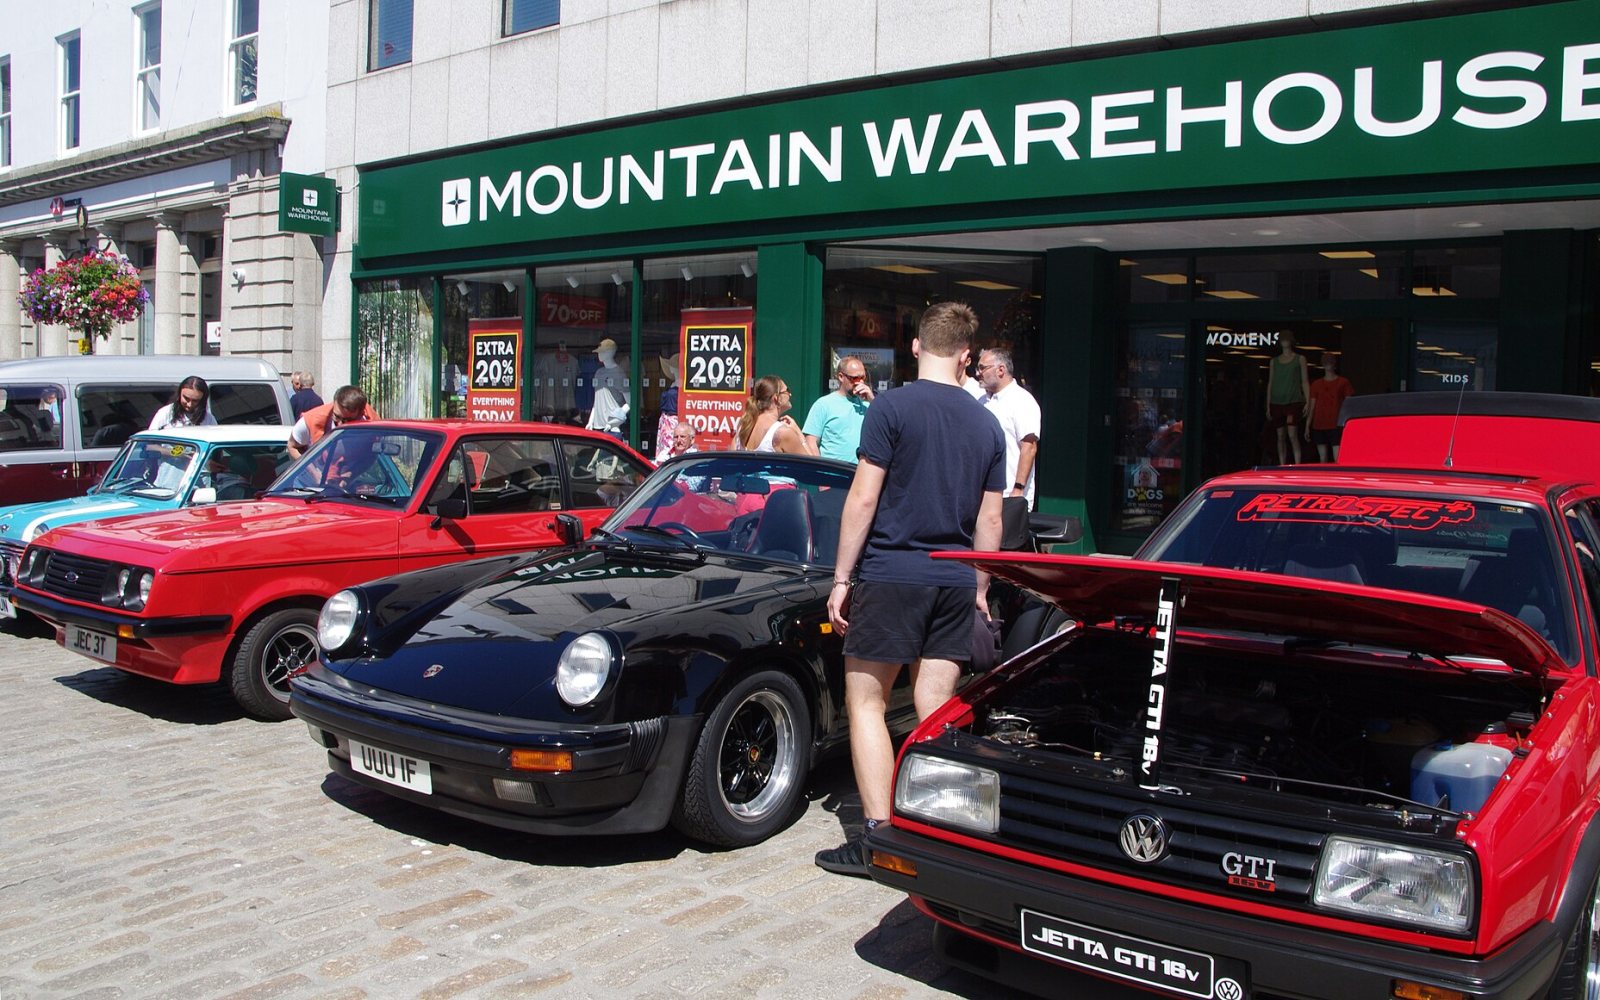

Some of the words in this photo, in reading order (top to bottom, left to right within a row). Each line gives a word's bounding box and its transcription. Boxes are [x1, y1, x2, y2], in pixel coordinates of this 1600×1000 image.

[478, 125, 843, 222] MOUNTAIN
[287, 212, 332, 223] WAREHOUSE
[291, 206, 328, 216] MOUNTAIN
[579, 309, 602, 321] OFF
[476, 340, 514, 356] EXTRA
[690, 334, 742, 352] EXTRA
[475, 360, 514, 384] 20%
[689, 356, 742, 384] 20%
[1442, 374, 1470, 383] KIDS
[472, 397, 515, 407] EVERYTHING
[685, 400, 743, 411] EVERYTHING
[472, 409, 515, 422] TODAY
[685, 414, 741, 433] TODAY
[1151, 588, 1174, 677] JETTA
[73, 629, 92, 651] JEC
[93, 635, 106, 656] 3T
[361, 745, 396, 779] UUU
[1222, 851, 1276, 882] GTI
[1032, 927, 1108, 960] JETTA
[1161, 959, 1199, 982] 16v
